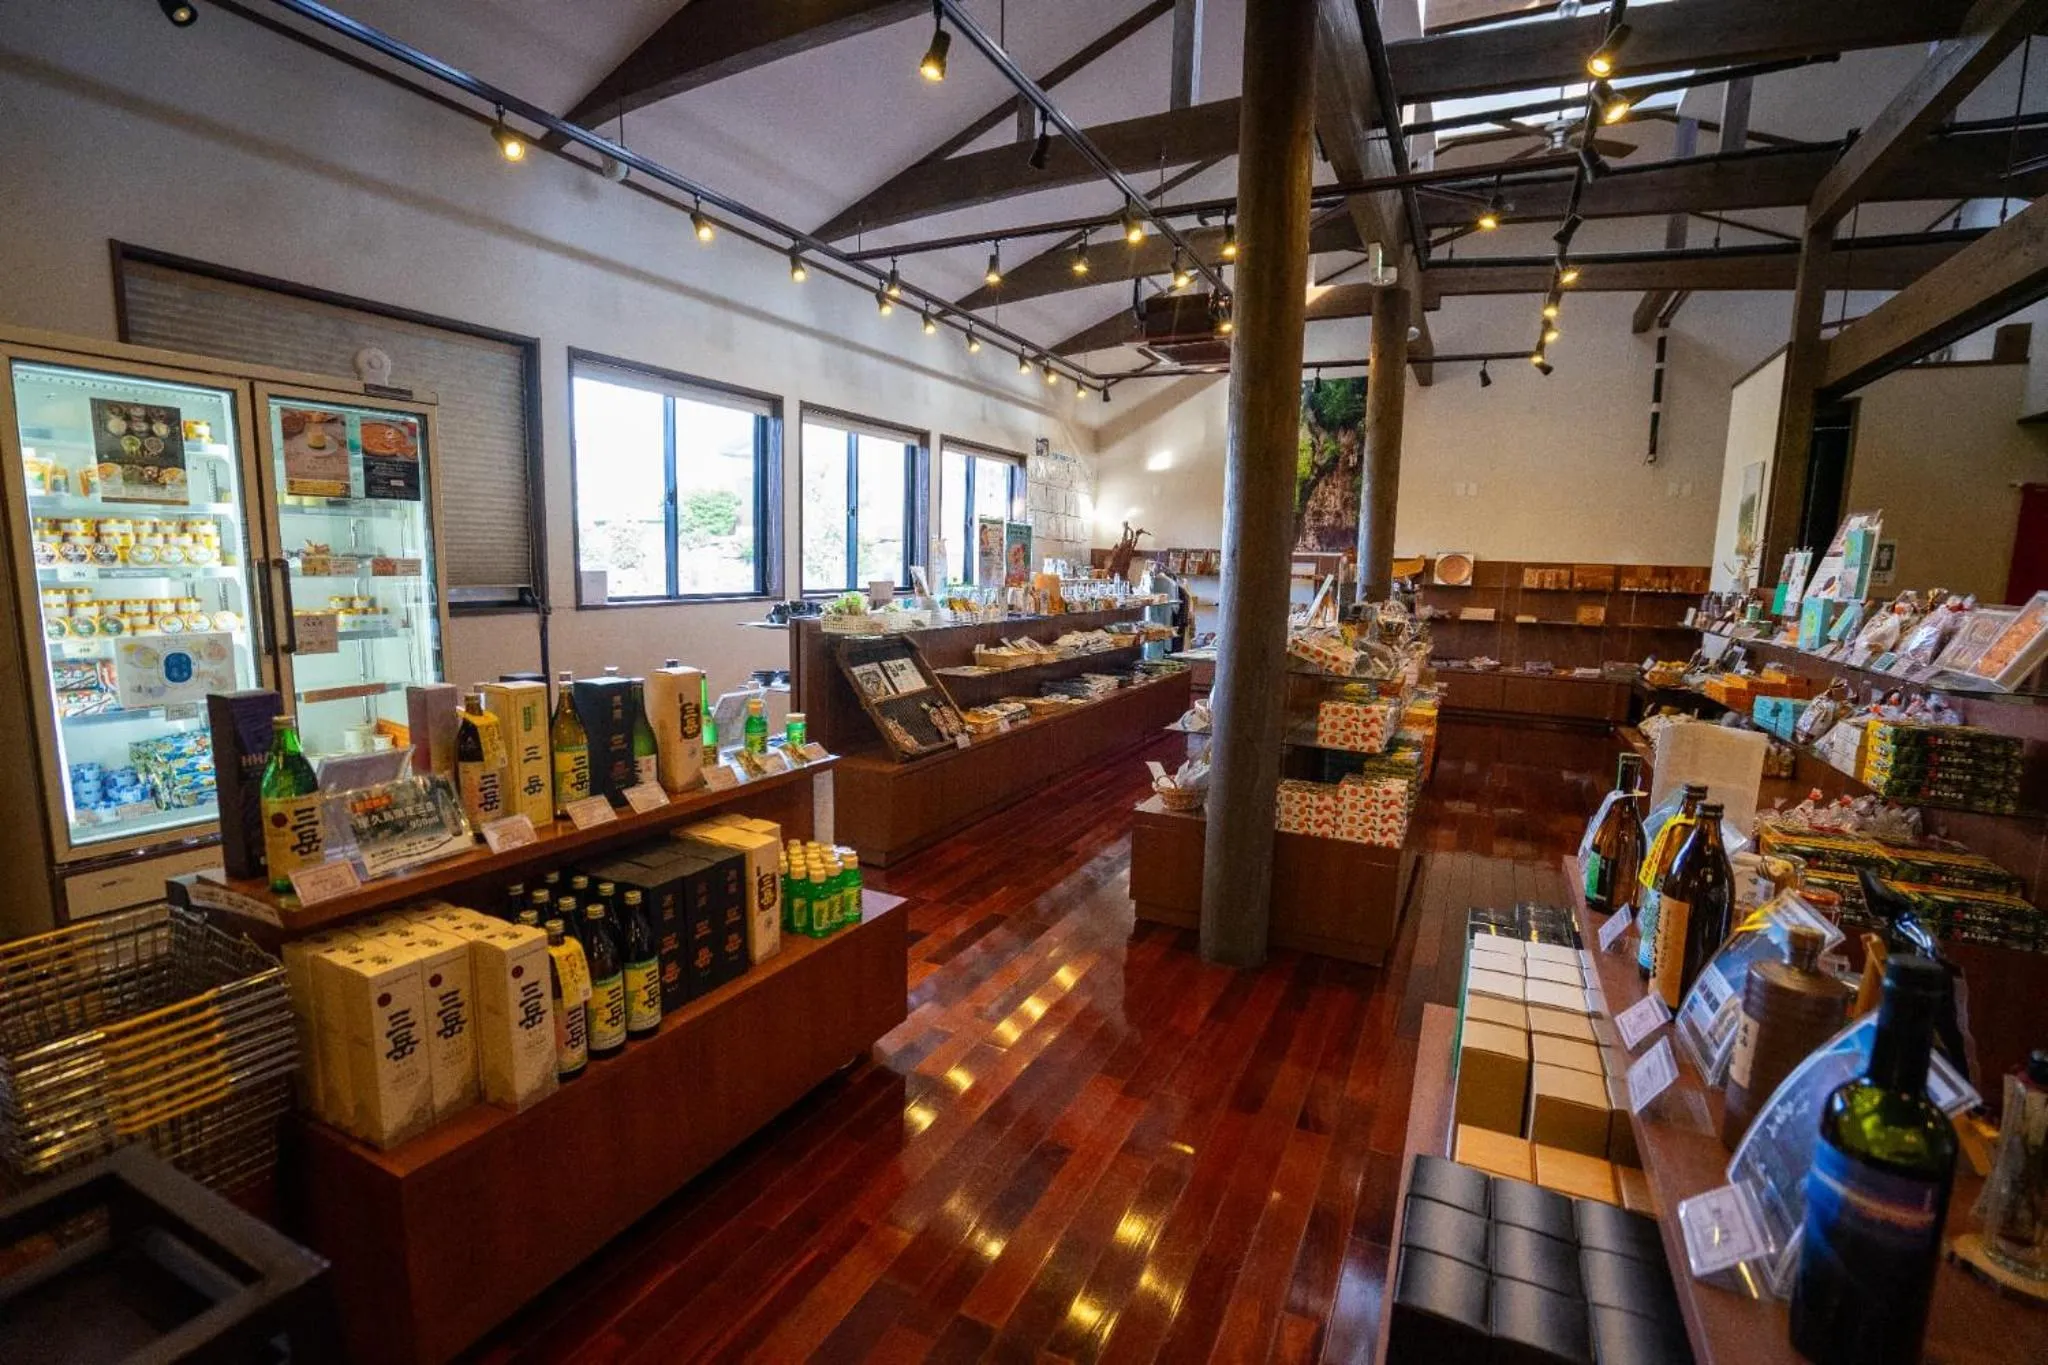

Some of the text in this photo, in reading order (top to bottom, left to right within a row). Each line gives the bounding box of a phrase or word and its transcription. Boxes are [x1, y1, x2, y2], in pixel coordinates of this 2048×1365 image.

[478, 773, 500, 813] 三岳
[523, 745, 545, 796] 三岳
[571, 756, 590, 792] 三岳
[290, 806, 323, 857] 三岳
[517, 980, 547, 1030] 三岳
[605, 986, 624, 1028] 三岳
[642, 967, 661, 1009] 三岳
[385, 1008, 421, 1062] 三岳
[436, 989, 468, 1040] 三岳
[564, 1007, 587, 1050] 三岳
